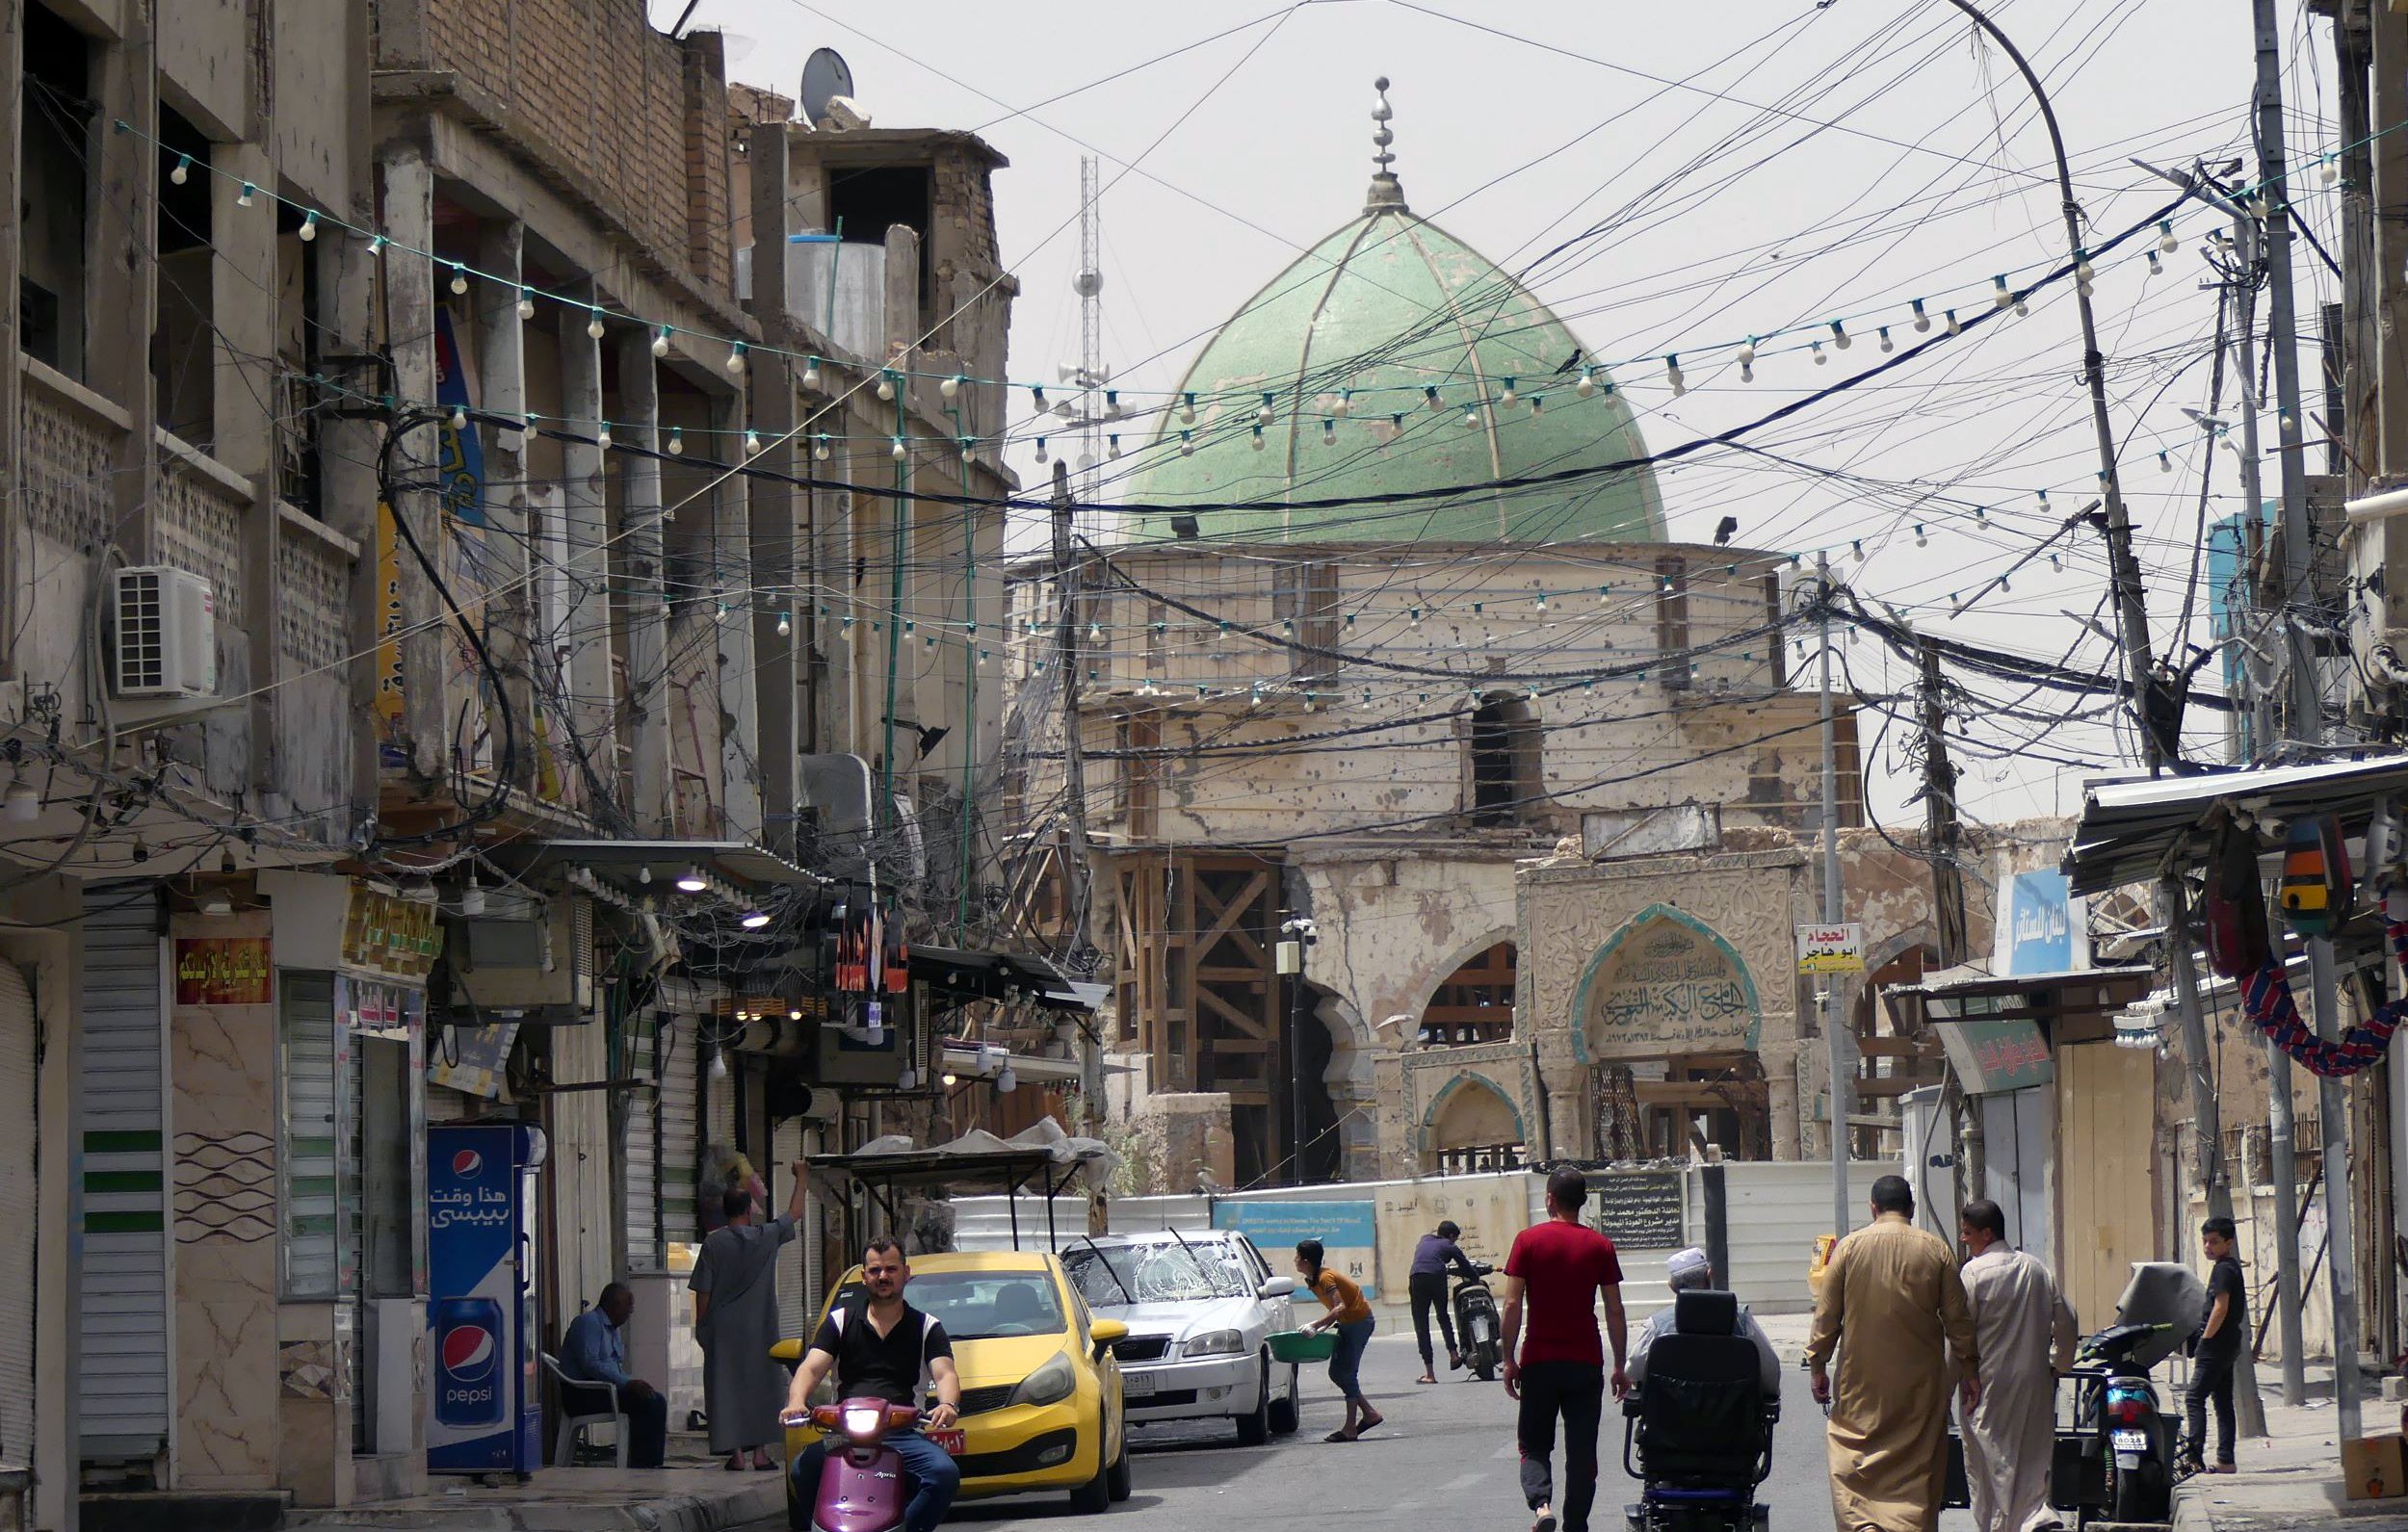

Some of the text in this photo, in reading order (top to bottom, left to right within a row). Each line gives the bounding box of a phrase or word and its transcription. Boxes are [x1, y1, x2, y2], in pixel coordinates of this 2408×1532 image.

[1807, 927, 1849, 946] الحجام
[1803, 943, 1857, 961] ابو هاجر
[430, 1186, 507, 1207] هذا وقت
[446, 1386, 492, 1405] pepsi
